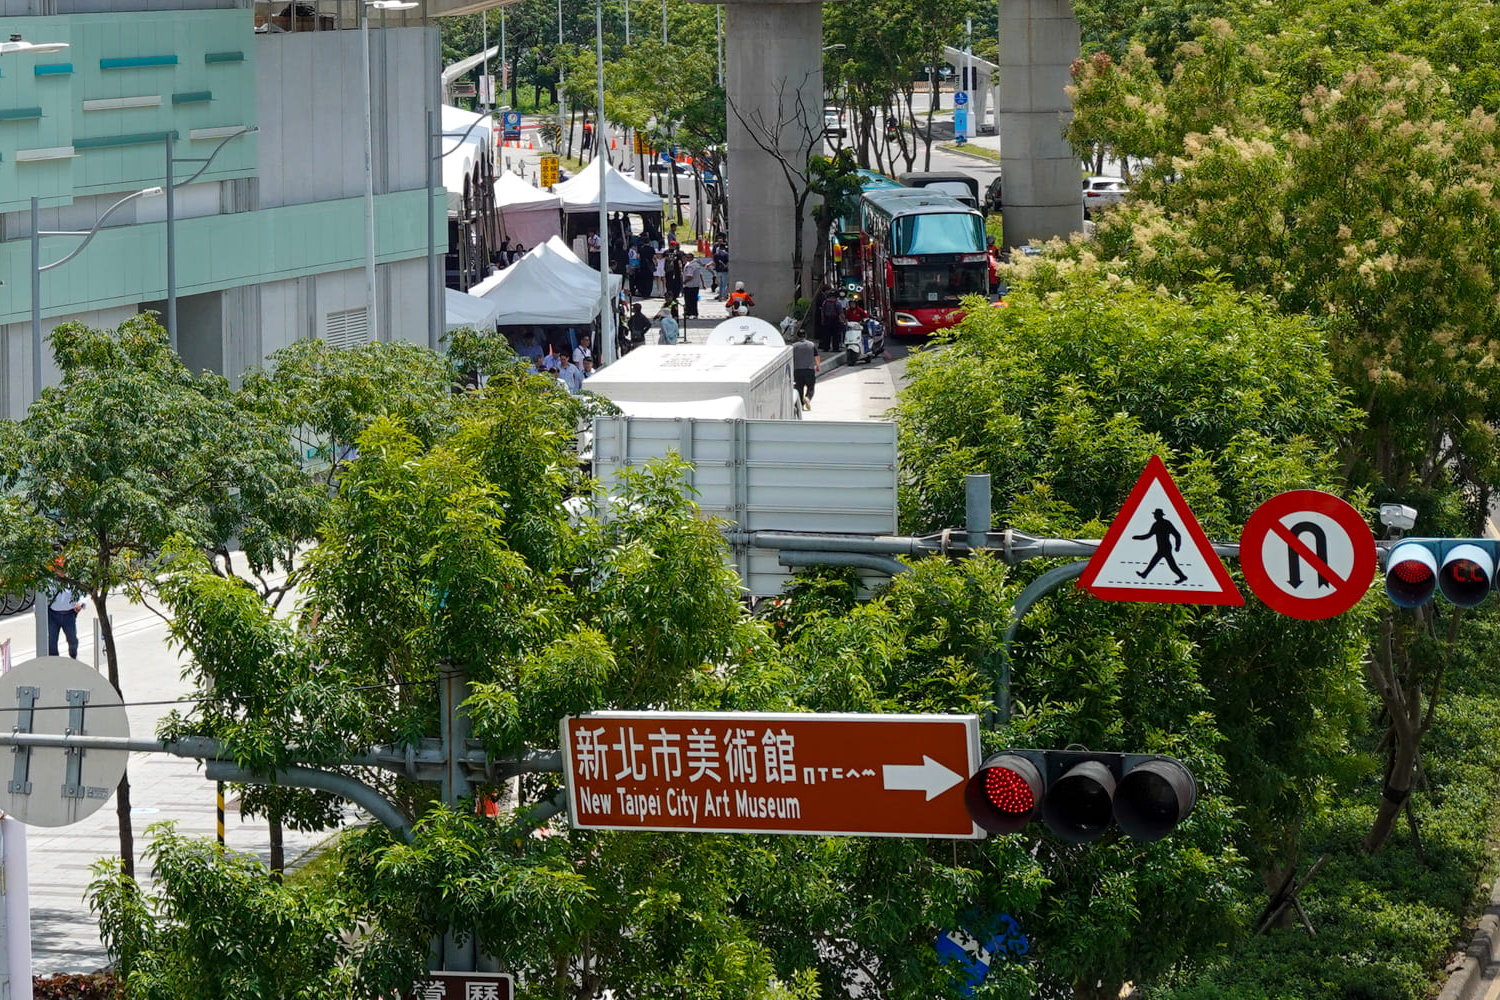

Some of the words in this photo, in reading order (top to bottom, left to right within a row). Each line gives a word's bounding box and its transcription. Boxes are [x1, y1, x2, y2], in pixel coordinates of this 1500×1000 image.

[575, 726, 797, 784] 新北市美術館
[579, 786, 611, 815] New
[616, 787, 661, 822] Taipei
[666, 787, 698, 824] City
[704, 788, 730, 817] Art
[735, 789, 800, 819] Museum
